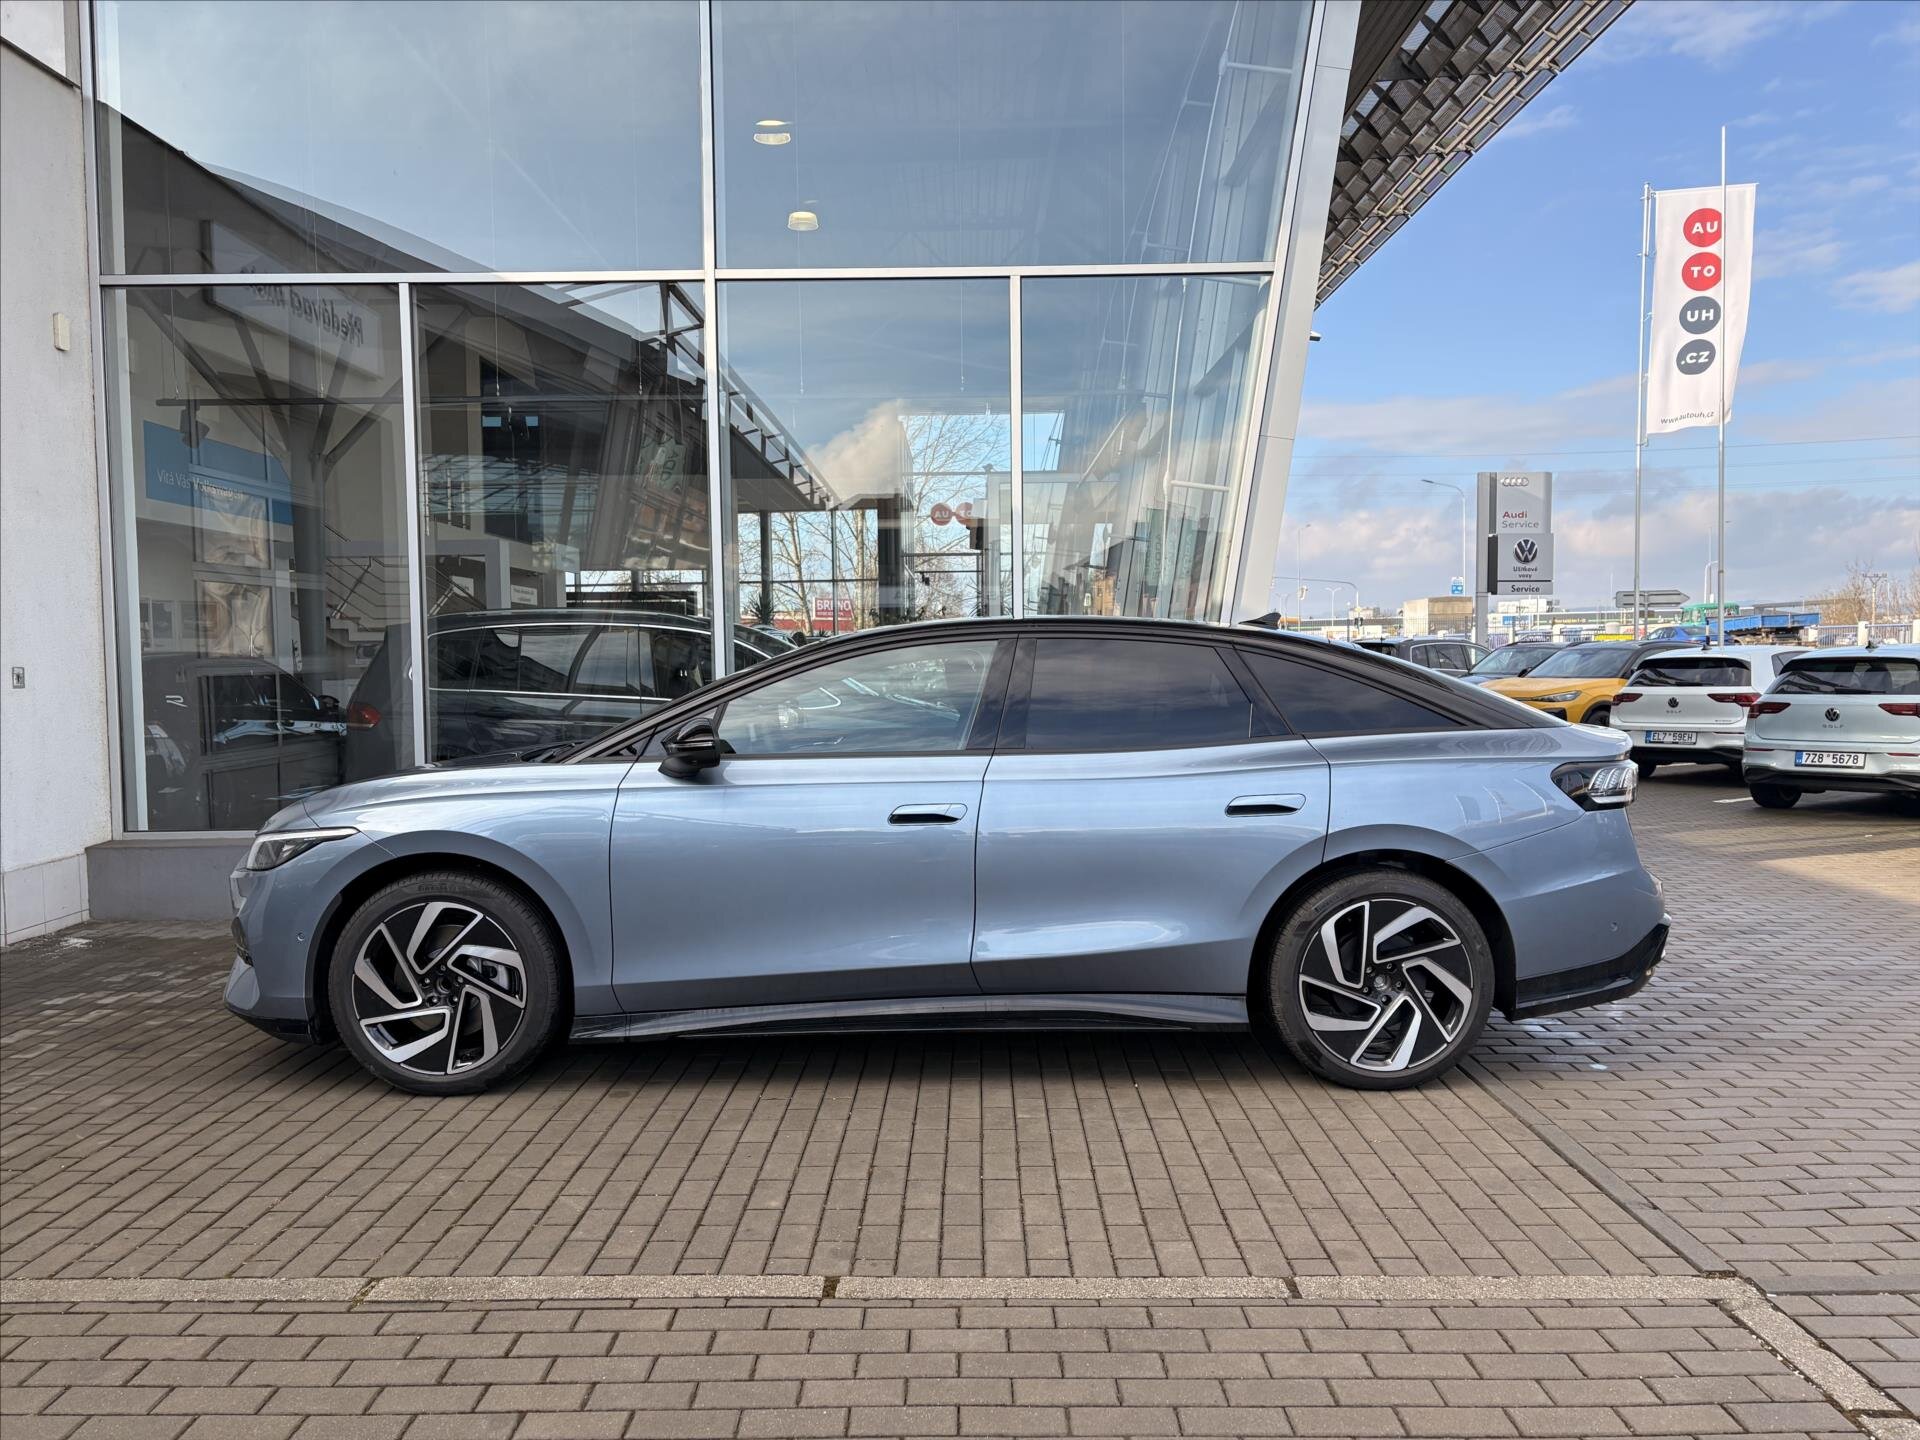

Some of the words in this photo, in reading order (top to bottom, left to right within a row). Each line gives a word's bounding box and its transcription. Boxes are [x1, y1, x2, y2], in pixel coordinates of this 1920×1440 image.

[1691, 220, 1719, 234] AU
[1690, 264, 1716, 278] TO
[1686, 308, 1715, 322] UH
[1680, 350, 1711, 365] .CZ
[1502, 510, 1528, 519] Audi
[1501, 521, 1540, 529] Service
[1511, 584, 1540, 593] Service
[1652, 732, 1667, 741] EL7
[1804, 753, 1824, 763] 7Z8
[1832, 754, 1859, 765] 5678
